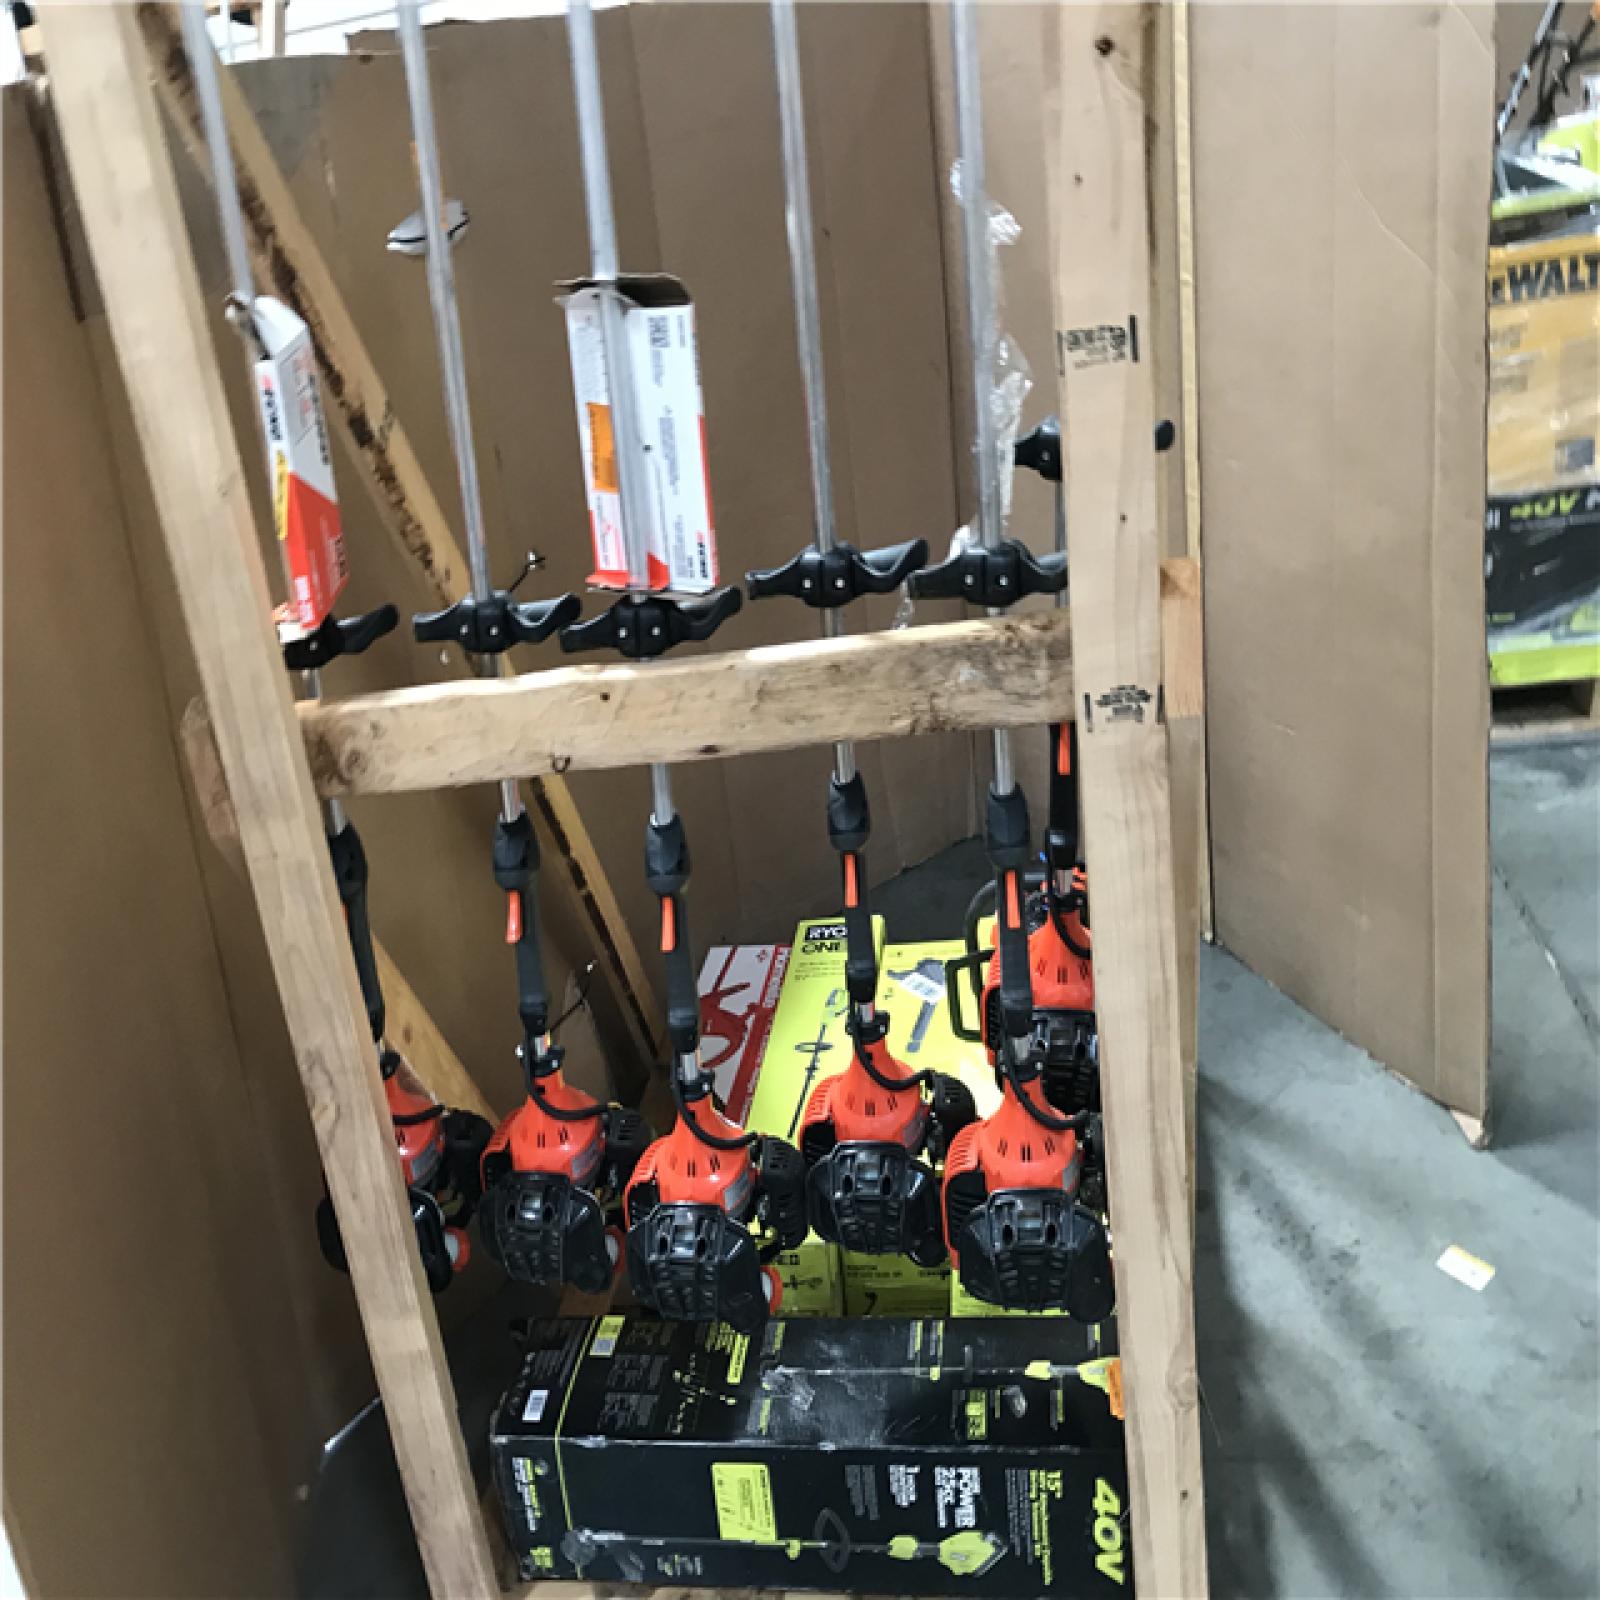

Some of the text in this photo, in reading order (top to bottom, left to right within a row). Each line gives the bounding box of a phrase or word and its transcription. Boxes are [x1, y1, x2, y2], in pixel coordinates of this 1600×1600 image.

[1490, 254, 1600, 305] EWALT
[808, 926, 848, 939] RYO
[1092, 1477, 1124, 1585] 40V
